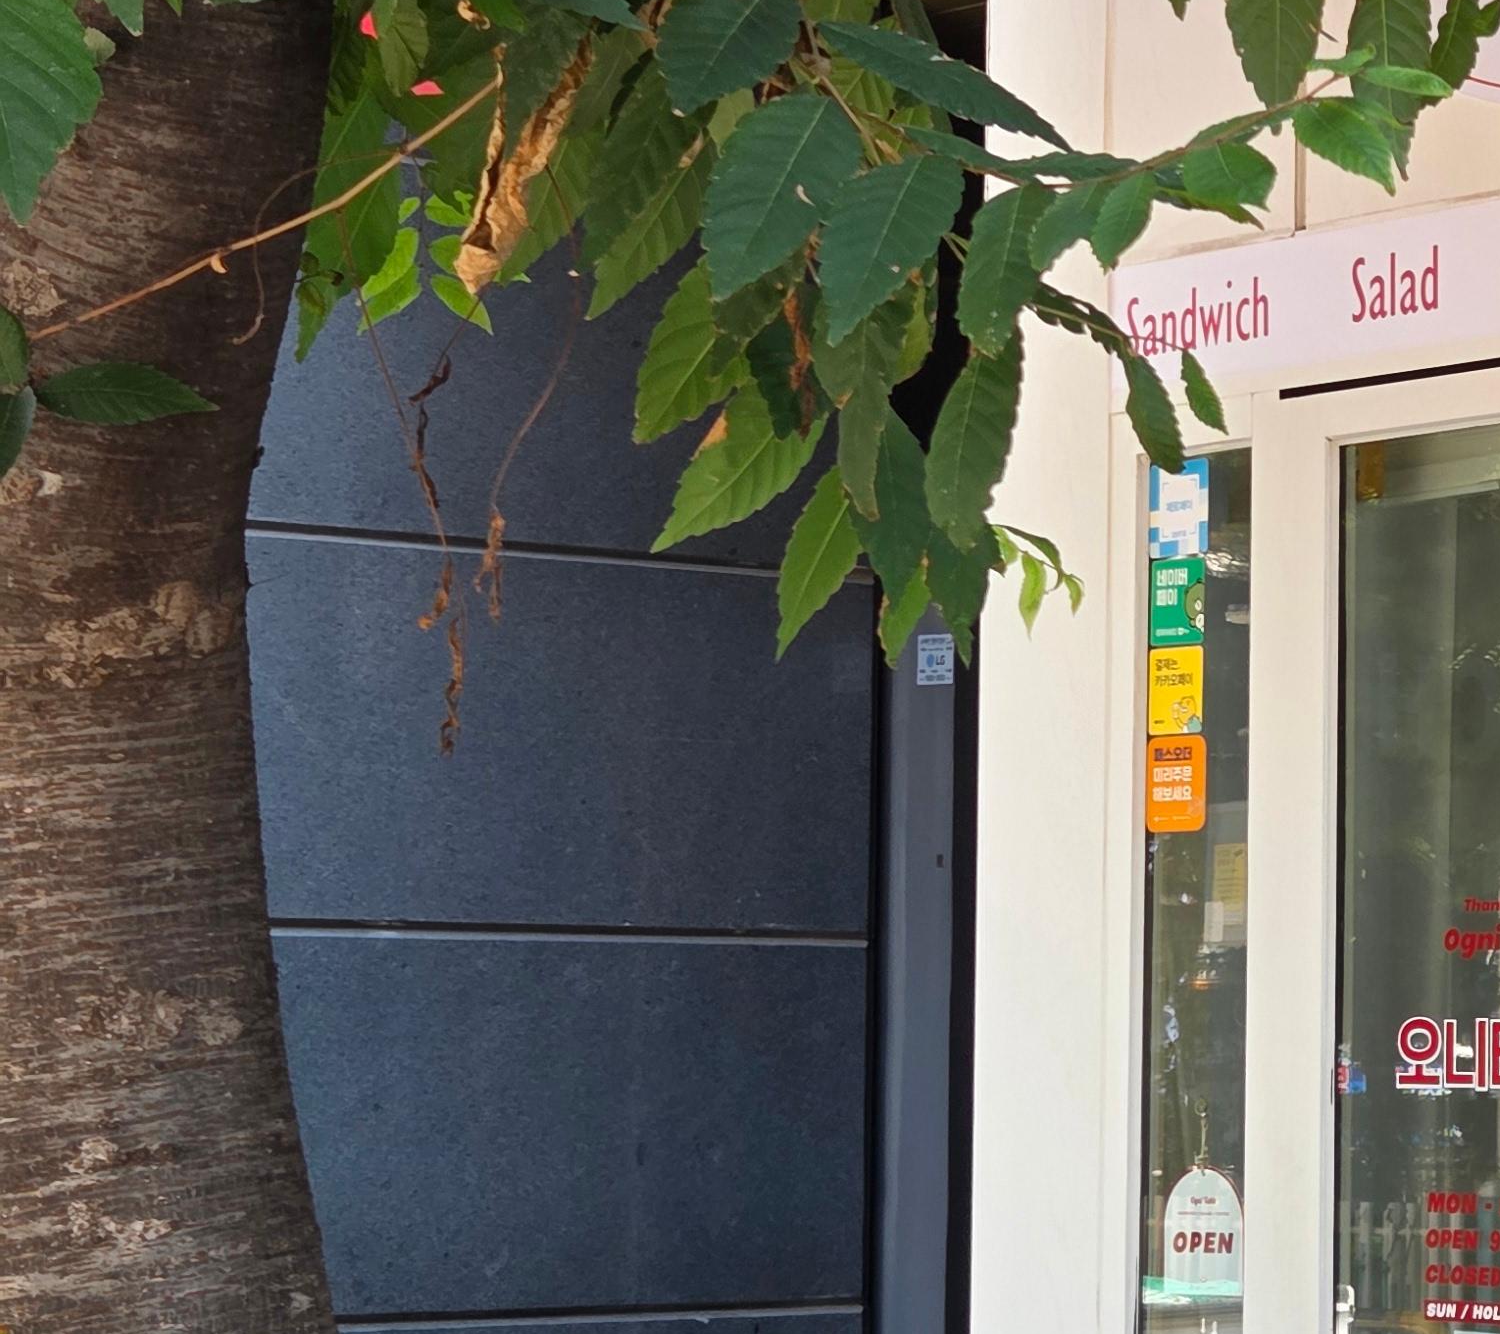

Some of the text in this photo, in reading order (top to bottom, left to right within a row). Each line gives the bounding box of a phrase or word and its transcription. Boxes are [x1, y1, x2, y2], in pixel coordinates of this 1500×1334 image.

[1351, 245, 1440, 323] Salad
[1127, 276, 1270, 357] Sandwich
[1156, 568, 1188, 586] 네이버
[1426, 1191, 1478, 1215] MON
[1173, 1231, 1234, 1254] OPEN
[1425, 1229, 1479, 1250] OPEN
[1426, 1302, 1457, 1319] SUN
